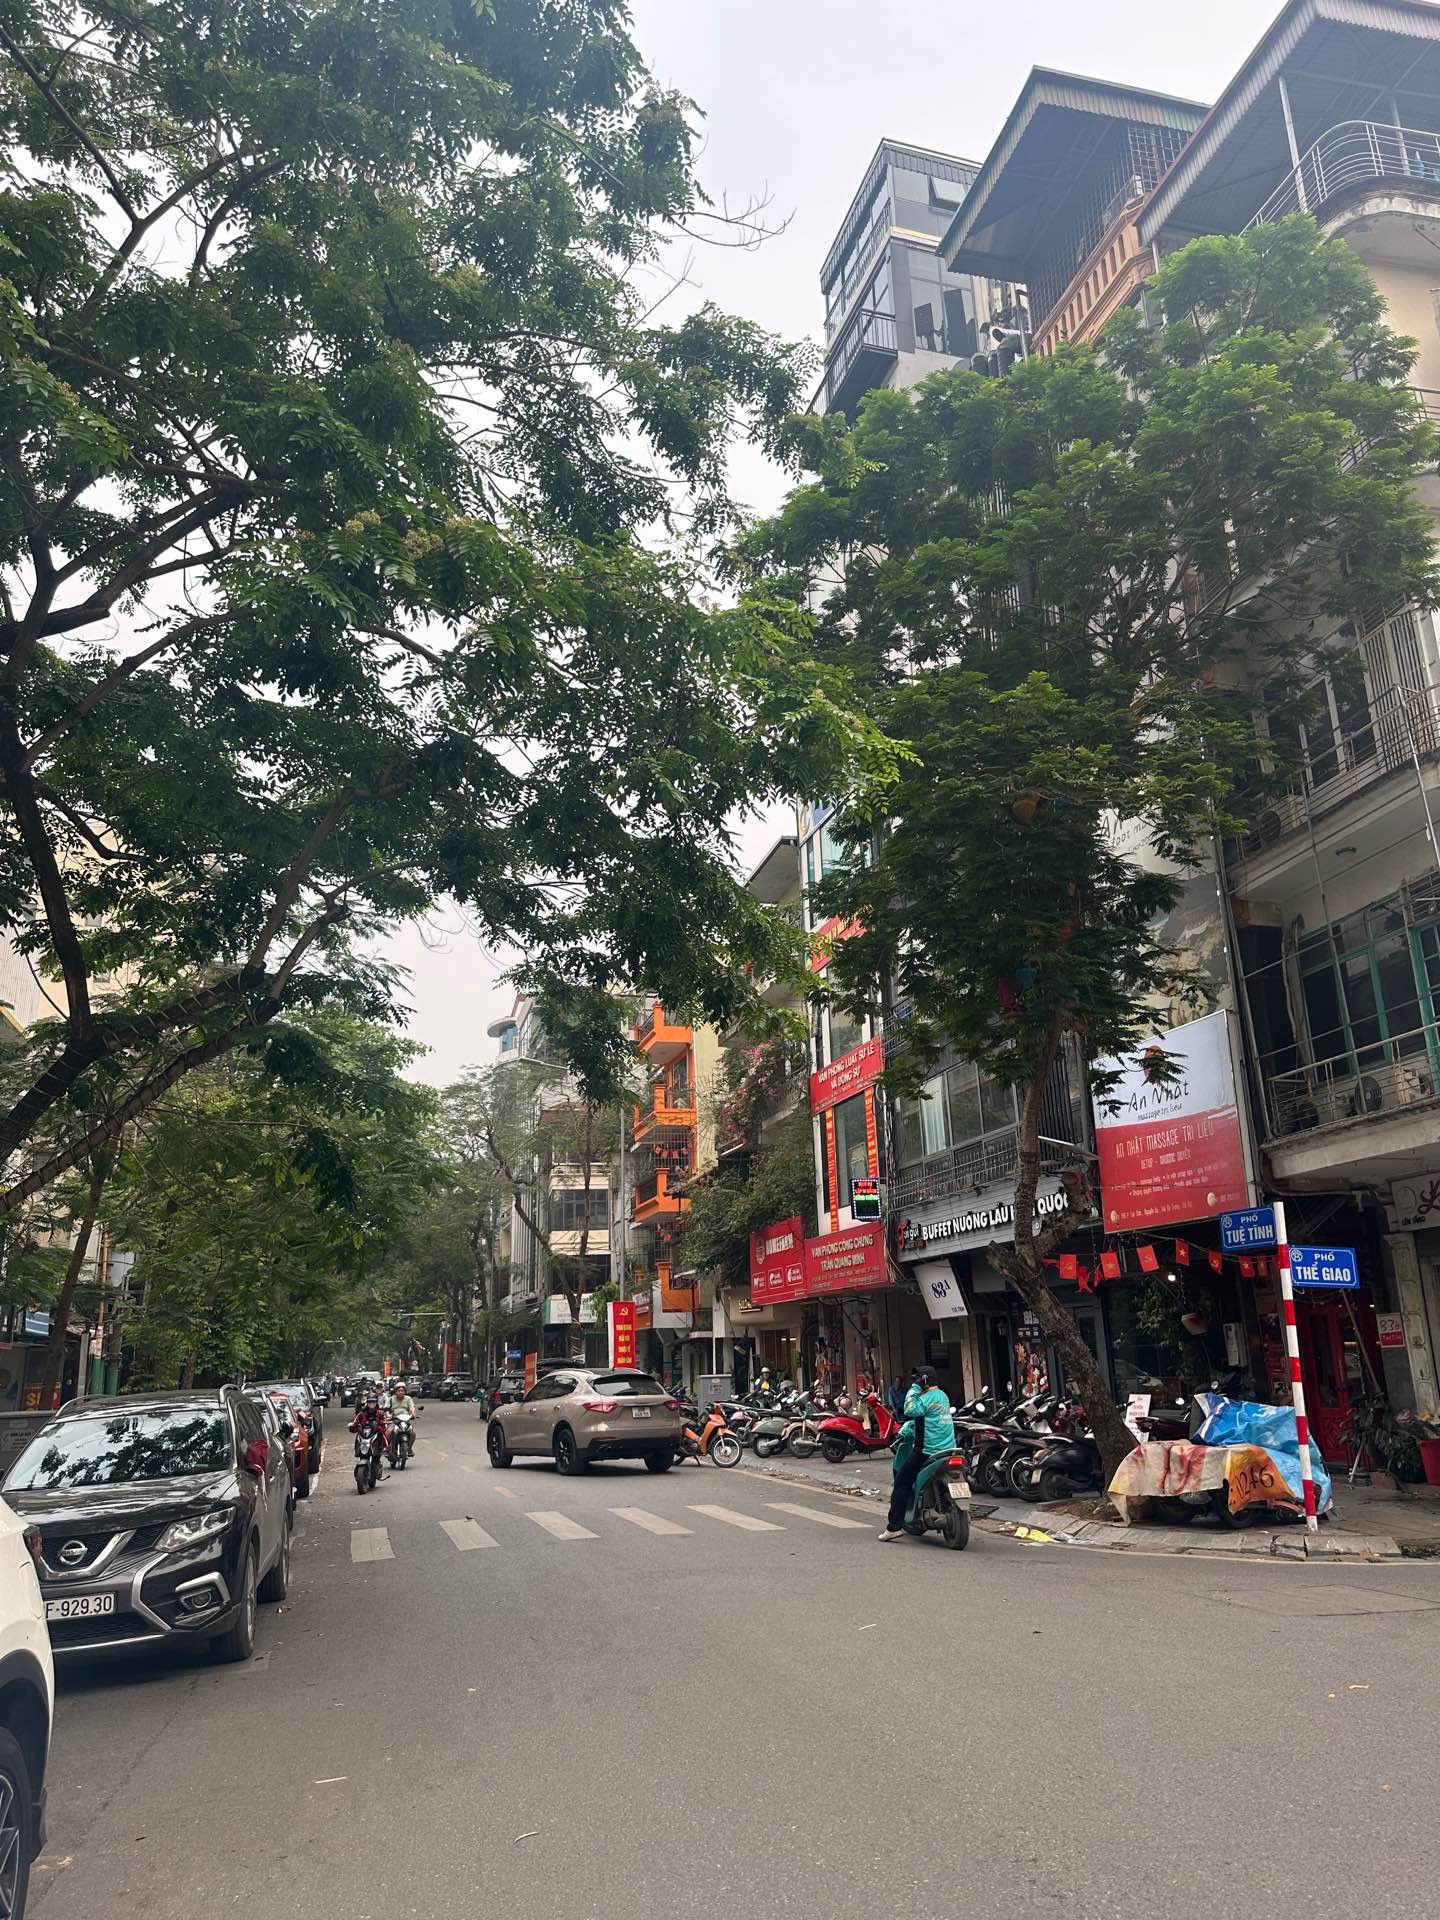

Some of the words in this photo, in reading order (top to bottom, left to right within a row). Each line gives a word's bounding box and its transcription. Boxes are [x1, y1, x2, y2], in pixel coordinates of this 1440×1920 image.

[1128, 1092, 1147, 1112] An
[1146, 1128, 1180, 1151] MASSAGE
[1240, 1212, 1258, 1224] PHỐ
[922, 1220, 952, 1240] BUFFET
[1226, 1225, 1246, 1245] TUỆ
[1247, 1224, 1273, 1240] TĨNH
[834, 1254, 852, 1269] QUANG
[1314, 1250, 1335, 1261] PHỐ
[1296, 1261, 1319, 1281] THỂ
[1321, 1267, 1352, 1282] GIAO
